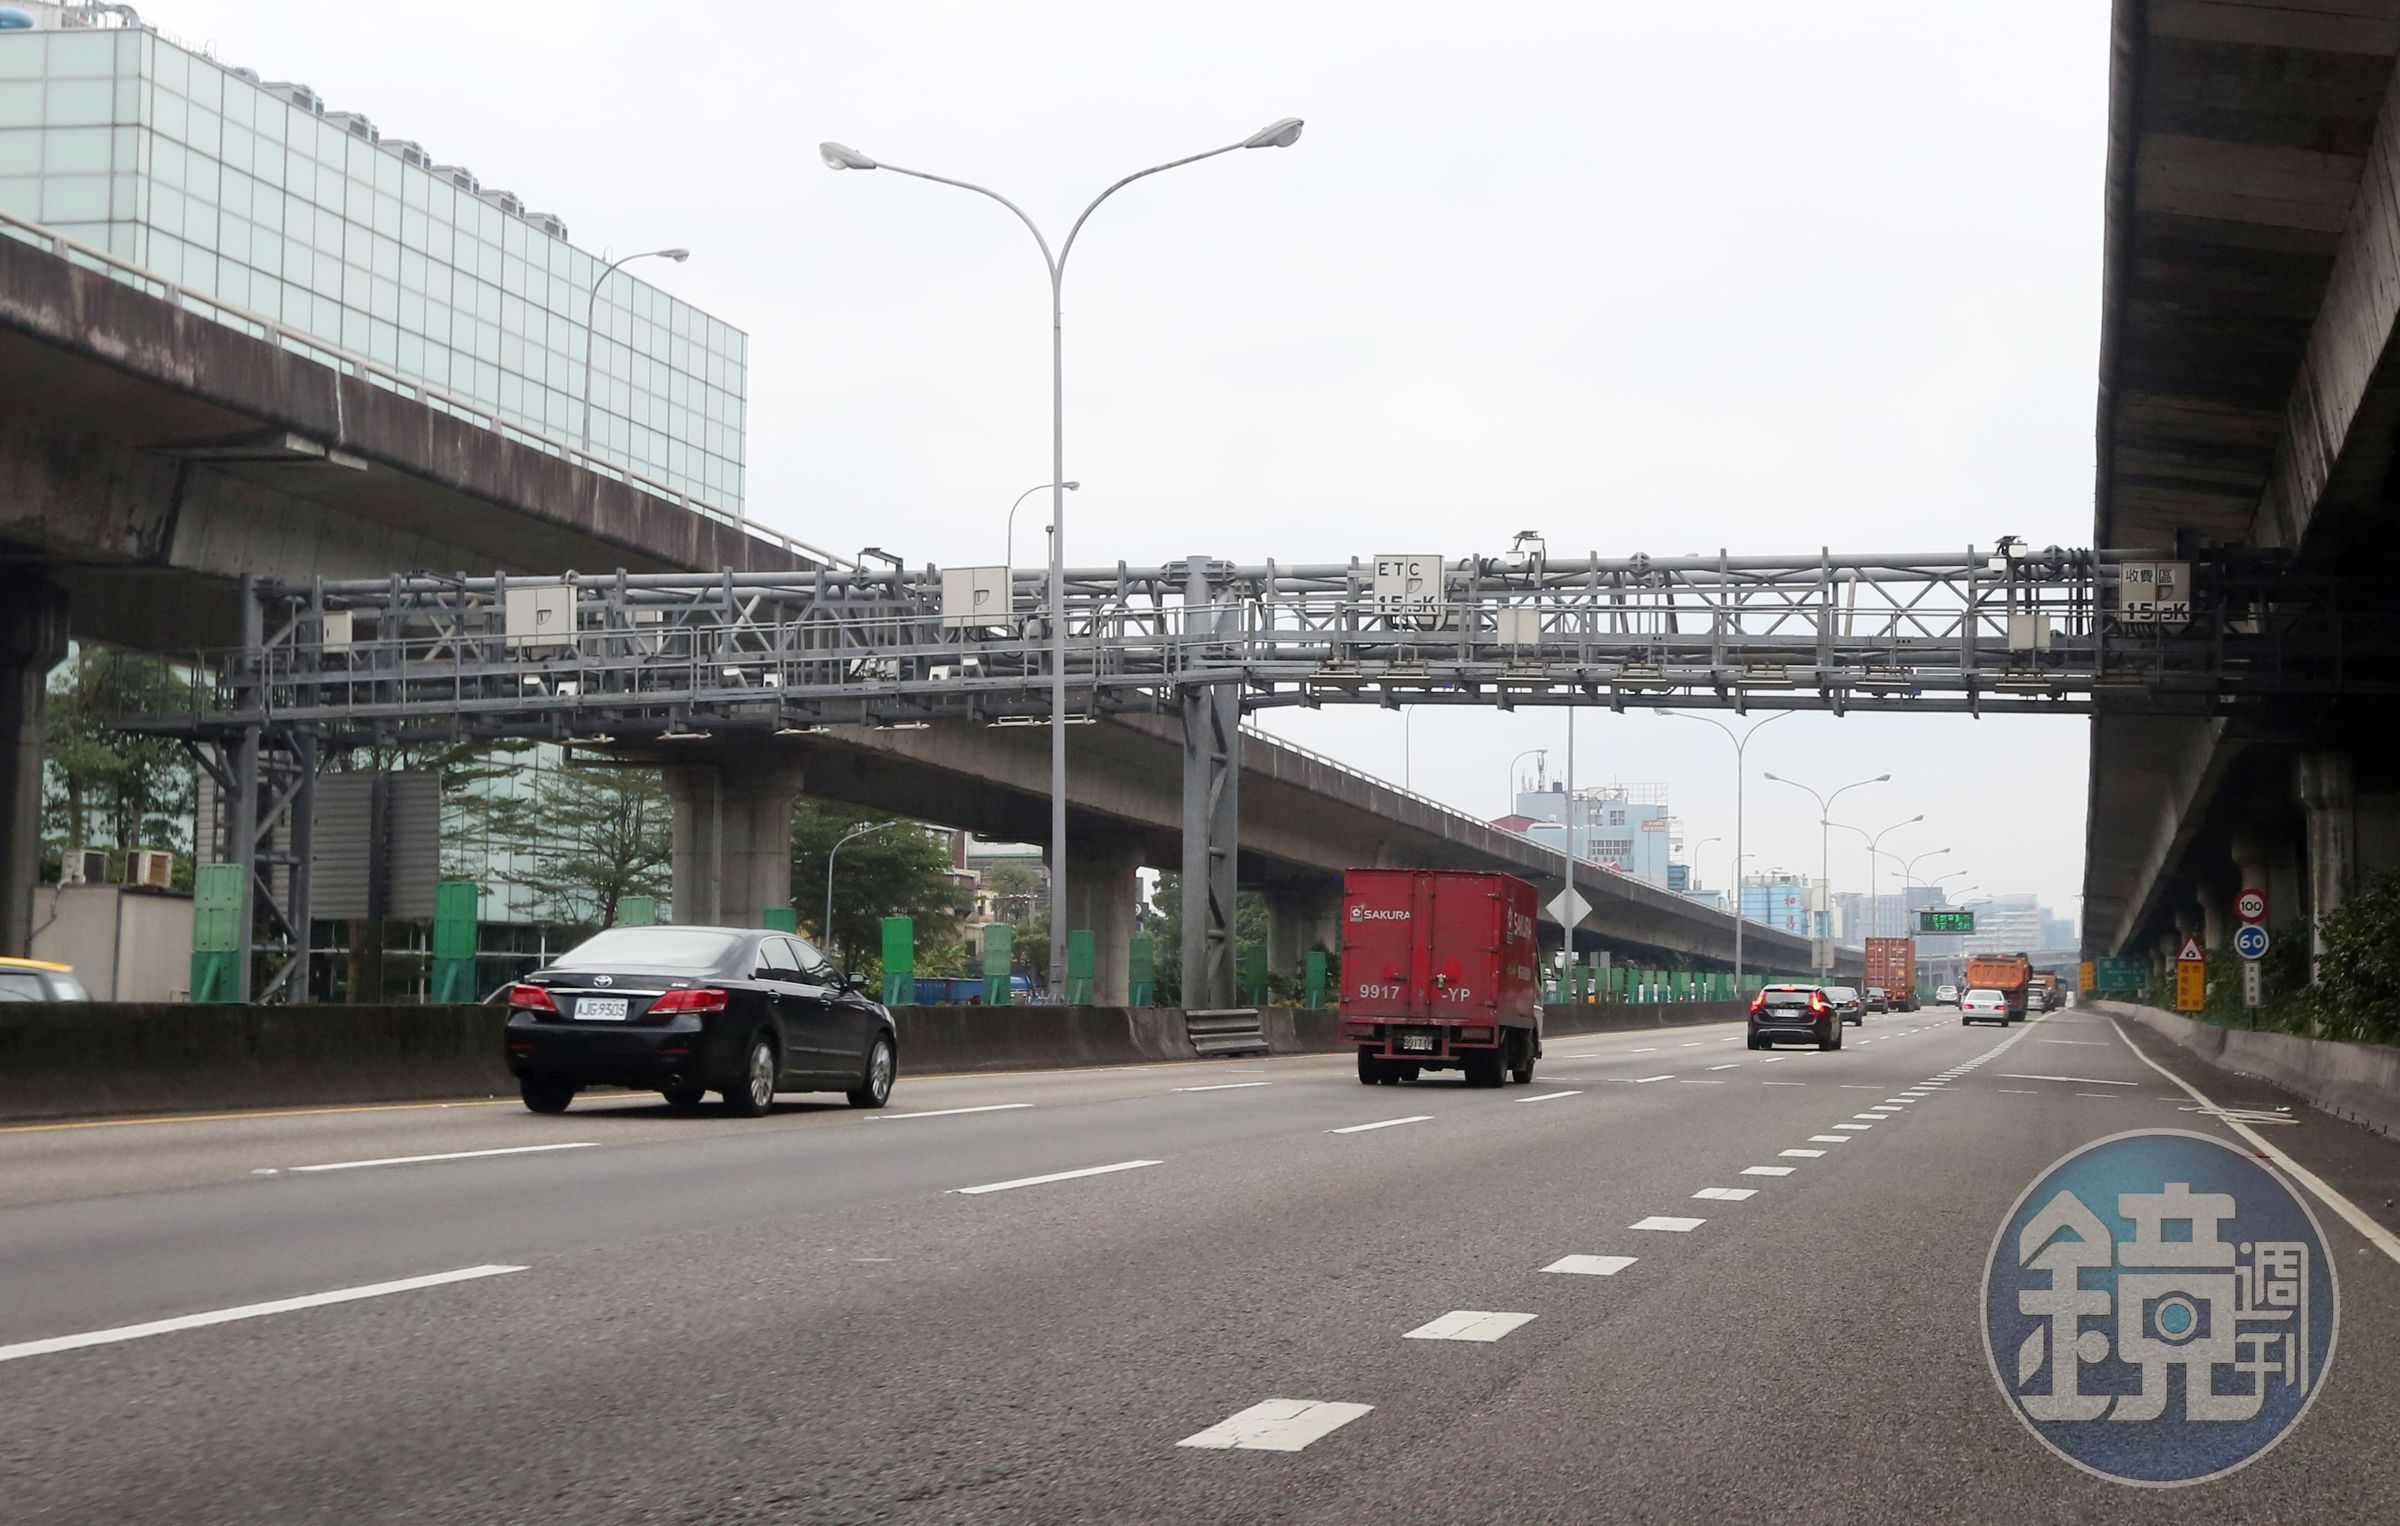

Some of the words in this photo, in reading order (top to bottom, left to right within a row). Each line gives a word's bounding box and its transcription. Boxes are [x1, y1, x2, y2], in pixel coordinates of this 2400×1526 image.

[1379, 562, 1420, 576] ETC
[2126, 569, 2173, 583] 收費區
[2128, 602, 2188, 620] 155K
[2241, 901, 2263, 911] 100
[1363, 910, 1411, 920] SAKURA
[2239, 935, 2264, 949] 60
[1360, 984, 1400, 999] 9917
